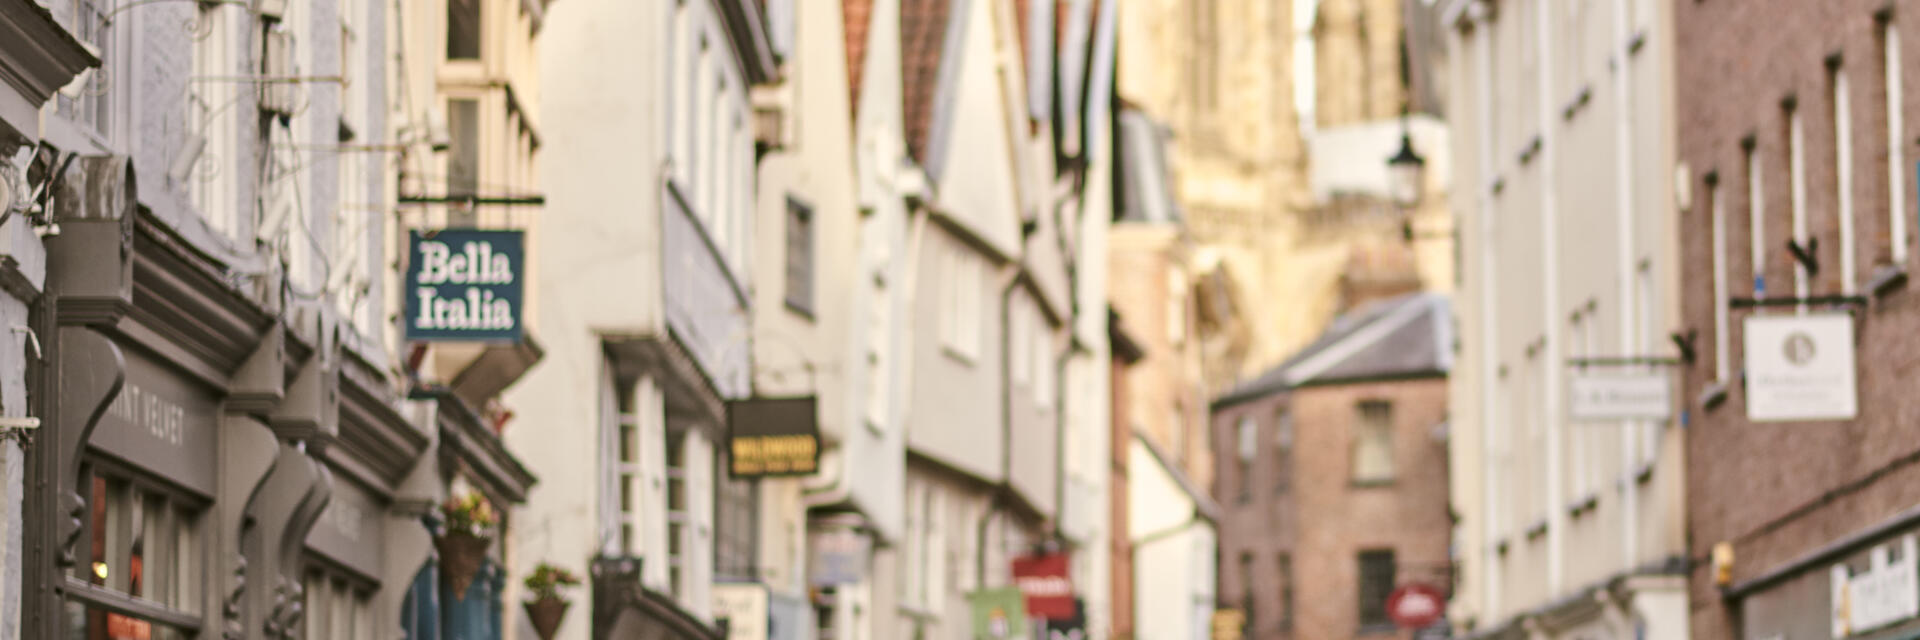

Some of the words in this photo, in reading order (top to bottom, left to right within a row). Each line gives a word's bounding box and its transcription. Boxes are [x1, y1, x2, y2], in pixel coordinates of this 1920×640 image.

[417, 240, 514, 285] Bella
[415, 286, 515, 330] Italia
[142, 390, 184, 447] VELVET
